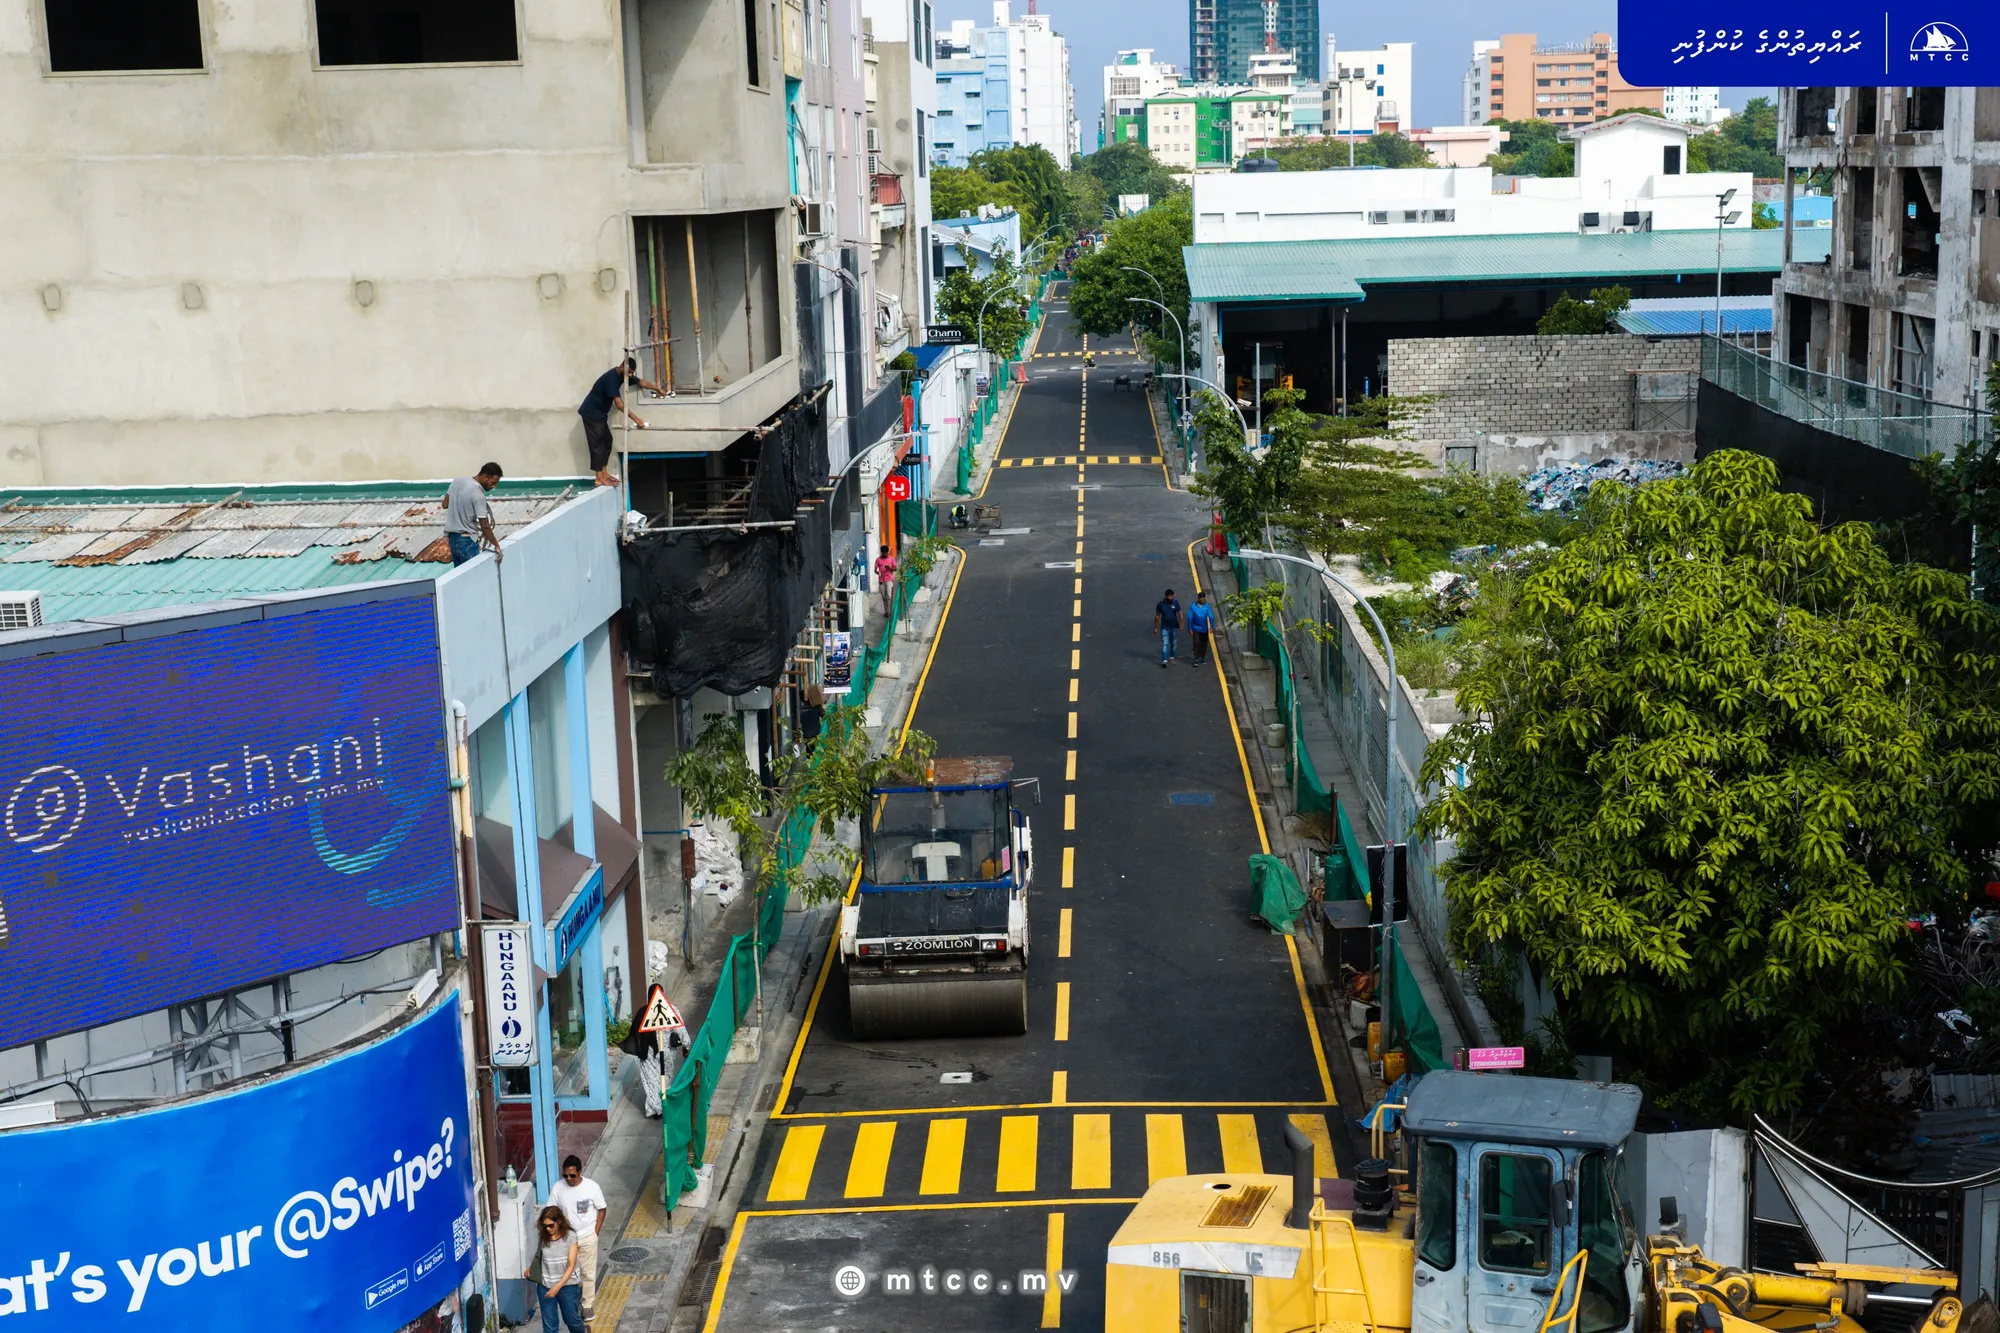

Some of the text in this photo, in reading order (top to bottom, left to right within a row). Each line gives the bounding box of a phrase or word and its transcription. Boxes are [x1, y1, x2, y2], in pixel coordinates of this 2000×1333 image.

[928, 328, 962, 338] Charm
[567, 883, 601, 943] HUNGAANU
[905, 940, 973, 950] ZOOMLION
[498, 932, 517, 1012] HUNGAANU
[117, 1225, 263, 1313] your
[273, 1116, 455, 1259] @Swipe?
[1152, 1251, 1181, 1265] 856
[378, 1283, 397, 1297] Google
[396, 1278, 407, 1287] Play
